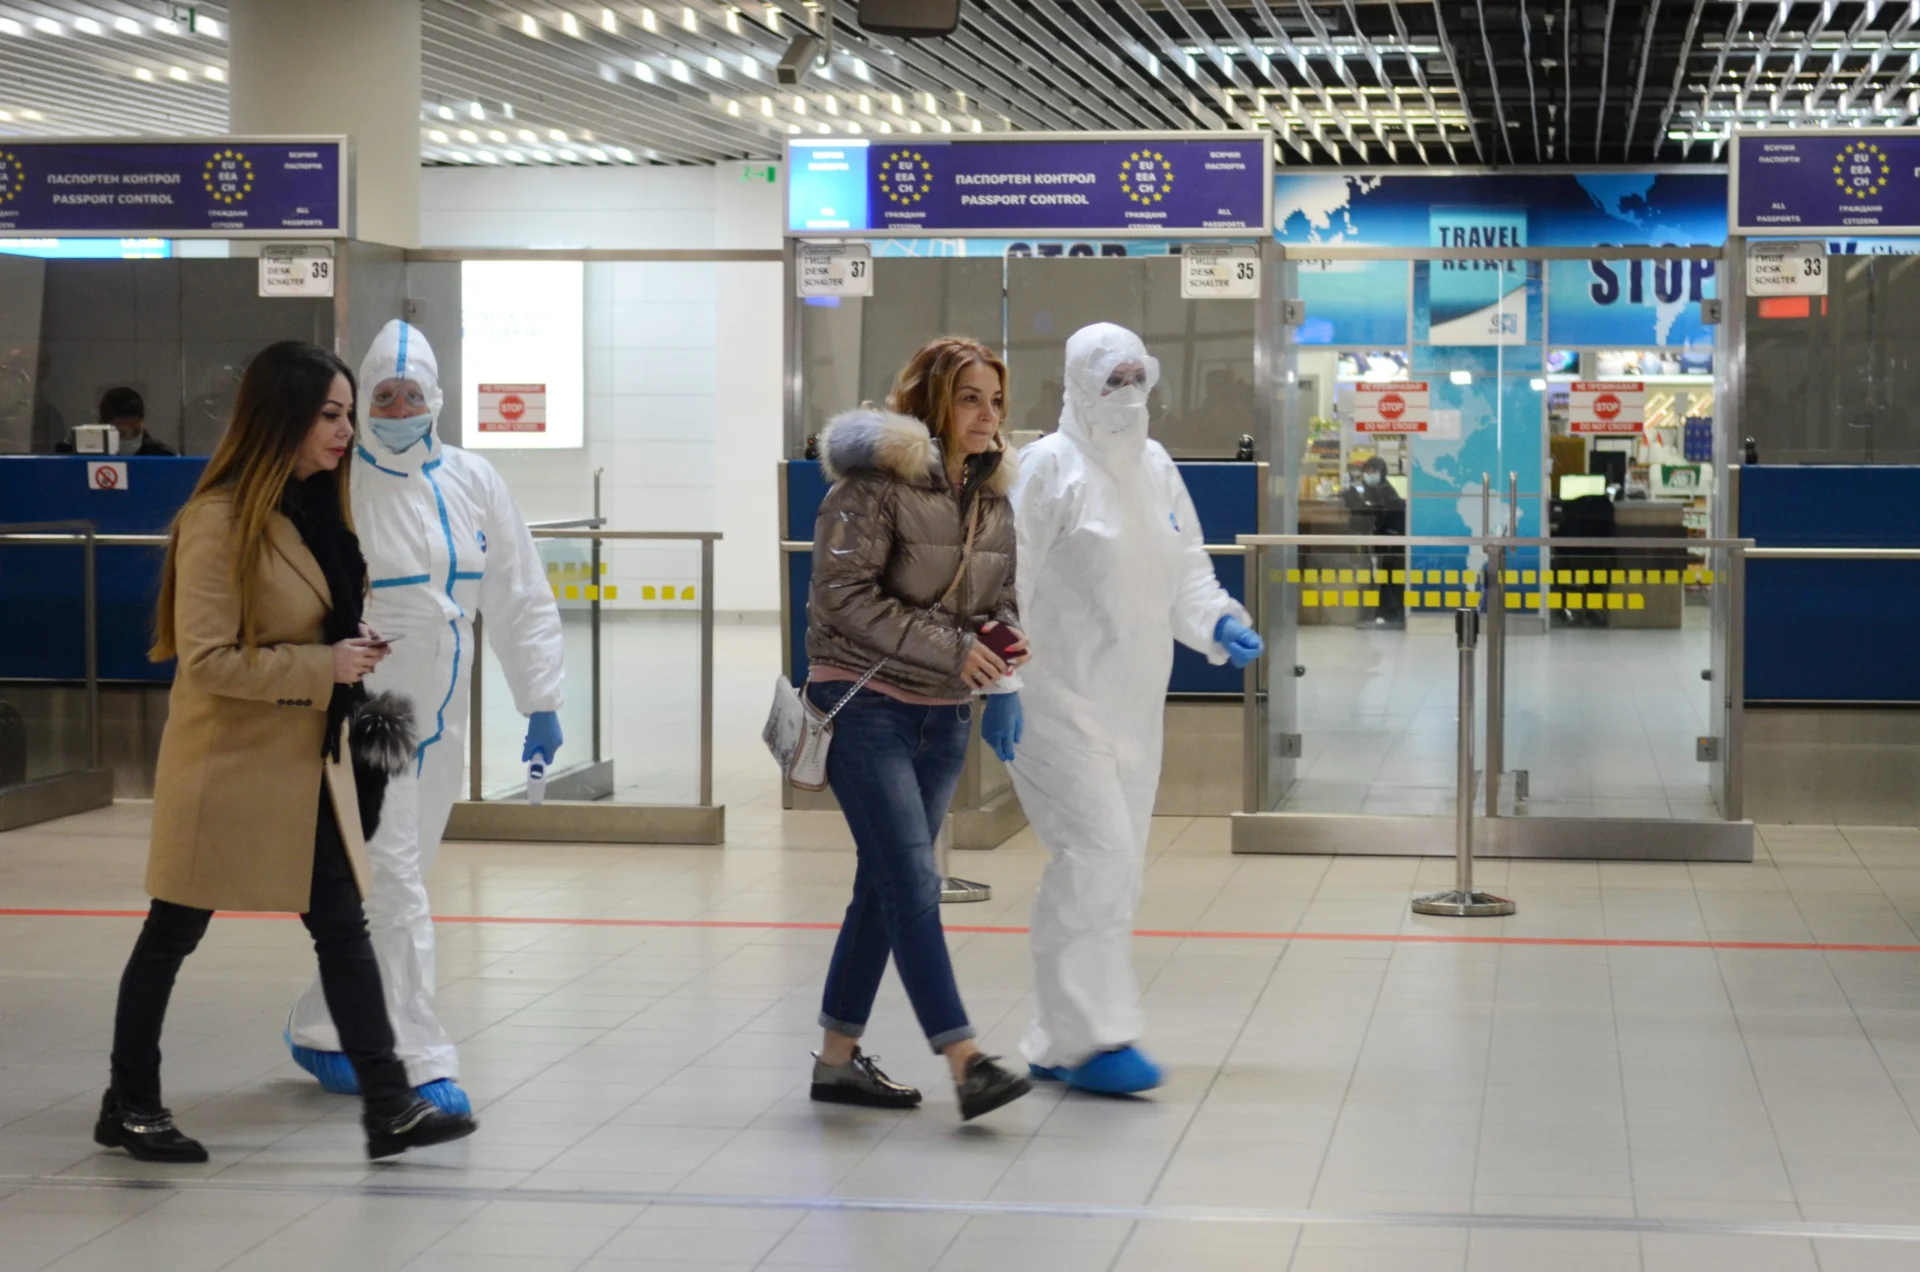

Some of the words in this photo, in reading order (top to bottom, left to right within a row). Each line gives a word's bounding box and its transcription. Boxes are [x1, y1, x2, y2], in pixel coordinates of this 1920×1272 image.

[1854, 154, 1869, 163] EU
[221, 161, 235, 170] EU
[899, 161, 913, 170] EU
[1139, 161, 1154, 170] EU
[1850, 165, 1871, 174] EEA
[47, 173, 120, 184] ПАСПОРТЕН
[122, 173, 181, 184] КОНТРОЛ
[218, 172, 238, 181] EEA
[895, 173, 916, 181] EEA
[955, 174, 1031, 185] ПАСПОРТЕН
[1034, 173, 1096, 184] КОНТРОЛ
[1135, 173, 1156, 181] EEA
[1853, 177, 1870, 186] CH
[53, 194, 114, 204] PASSPORT
[118, 194, 174, 204] CONTROL
[961, 195, 1027, 205] PASSPORT
[1029, 194, 1089, 205] CONTROL
[1772, 202, 1786, 210] ALL
[1439, 226, 1520, 248] TRAVEL
[312, 262, 328, 279] 39
[851, 261, 866, 278] 37
[1237, 262, 1254, 280] 35
[1756, 265, 1781, 273] DESK
[1804, 258, 1821, 276] 33
[805, 268, 829, 276] DESK
[1190, 268, 1216, 276] DESK
[1590, 243, 1716, 305] STOP
[1189, 279, 1230, 287] SCHALTER
[1755, 276, 1796, 285] SCHALTER
[501, 403, 523, 413] STOP
[1380, 402, 1403, 413] STOP
[1596, 402, 1619, 413] STOP
